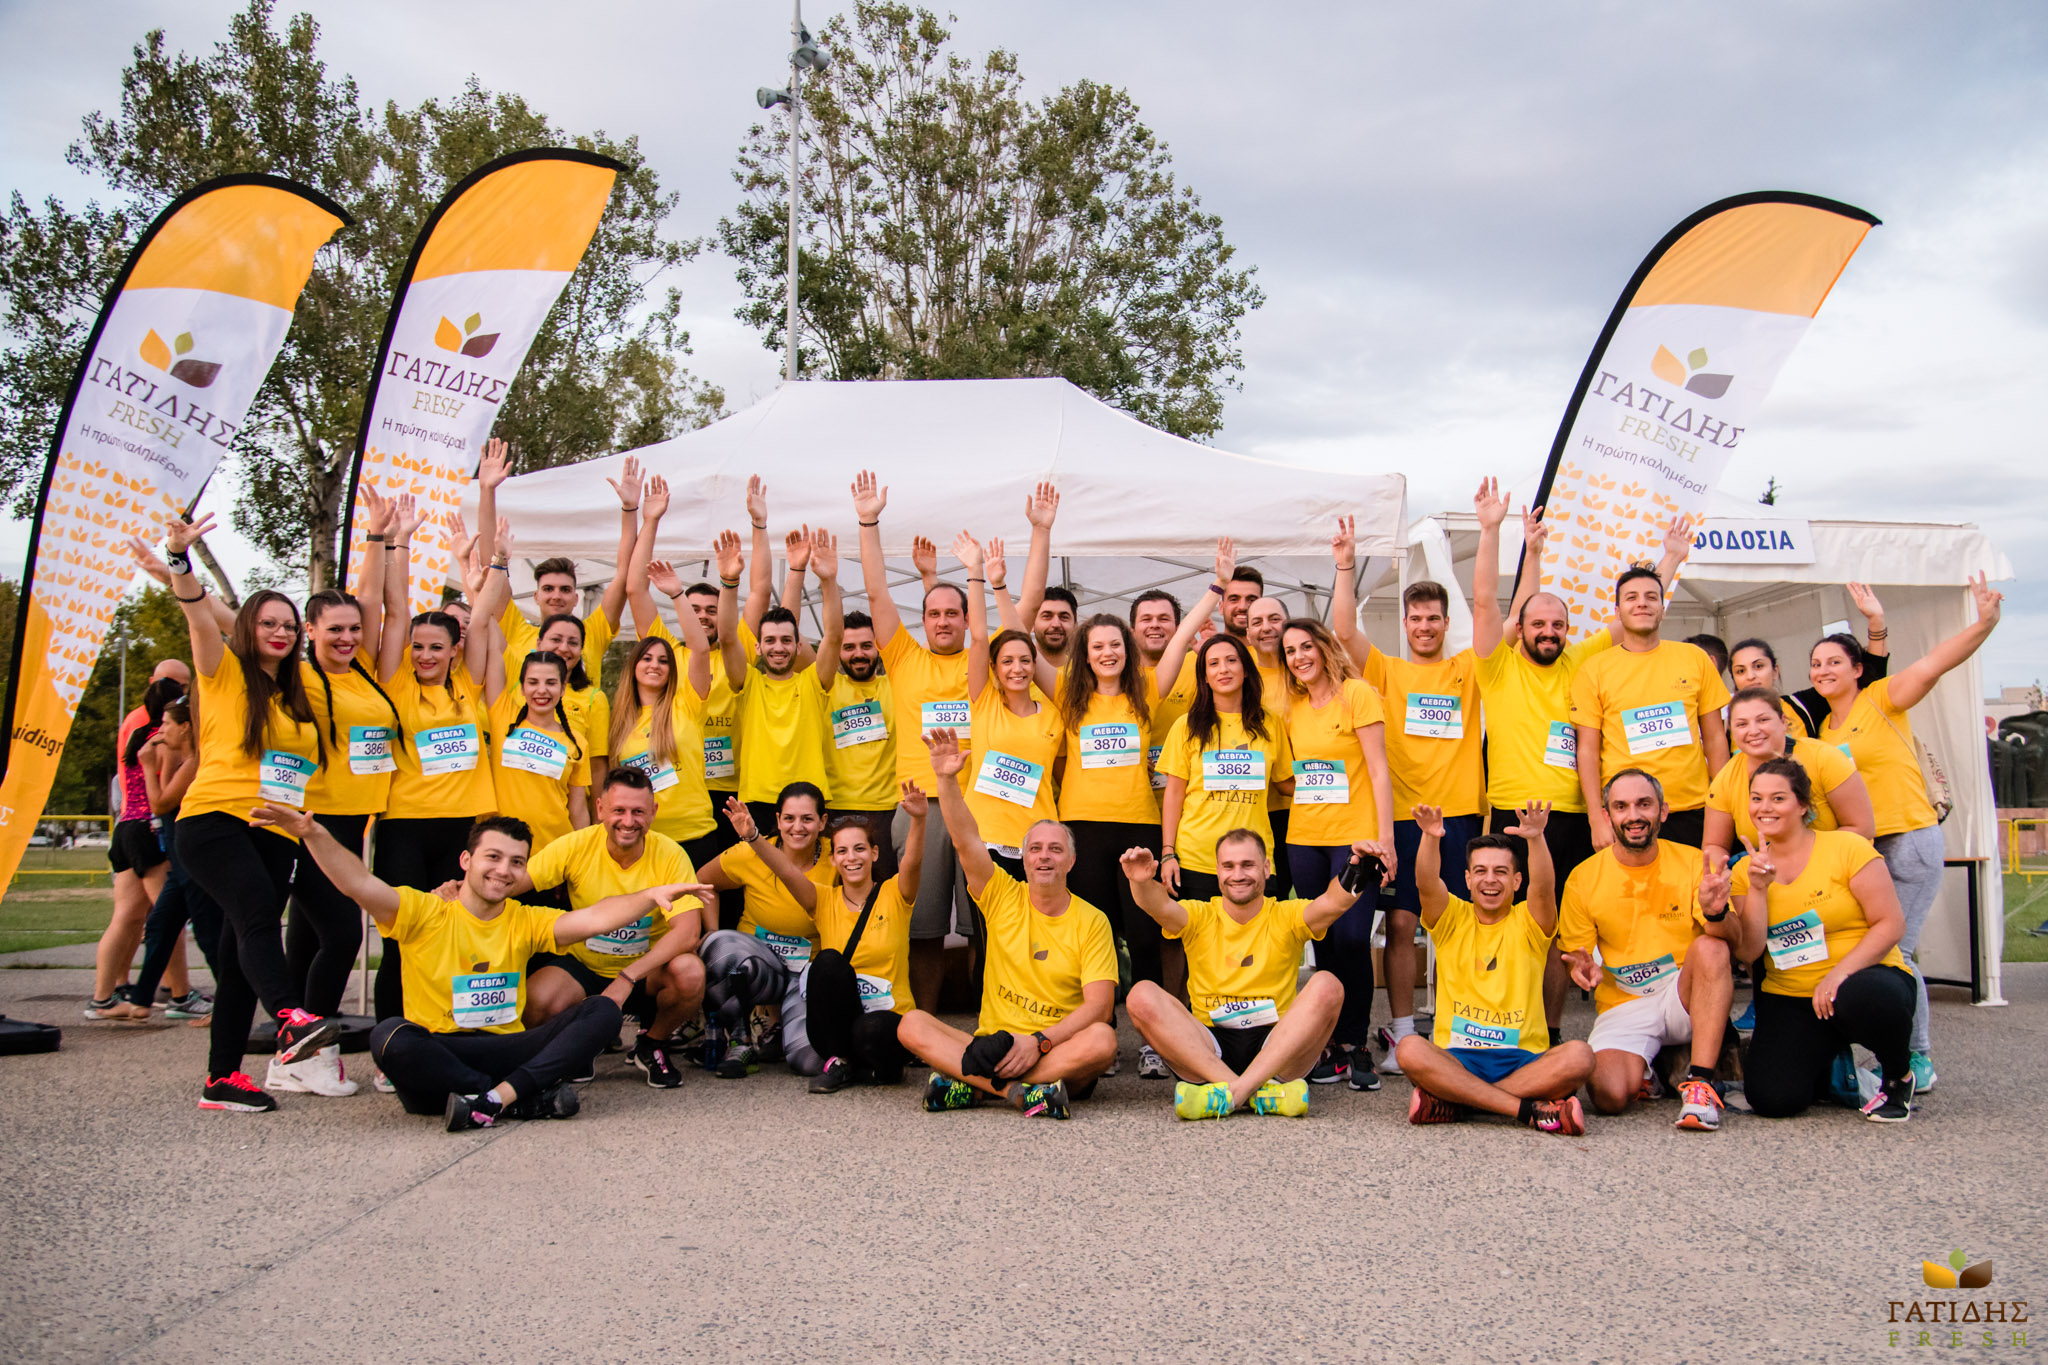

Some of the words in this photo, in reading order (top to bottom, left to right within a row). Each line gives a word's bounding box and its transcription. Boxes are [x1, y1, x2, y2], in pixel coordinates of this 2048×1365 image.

[387, 351, 508, 404] ΓΑΤΙΔΗΣ
[89, 357, 237, 448] ΓΑΤΙΔΗΣ
[412, 390, 465, 418] FRESH
[1592, 371, 1745, 448] ΓΑΤΙΔΗΣ
[80, 424, 91, 437] Η
[108, 400, 186, 449] FRESH
[1618, 415, 1701, 463] FRESH
[1582, 435, 1594, 449] Η
[1594, 443, 1638, 465] πρώτη
[1639, 454, 1708, 495] καλημέρα!
[1420, 697, 1453, 707] ΜΕΒΓΑΛ
[841, 706, 870, 718] ΜΕΒΓΑΛ
[935, 711, 967, 722] 3873
[1419, 709, 1452, 721] 3900
[1636, 706, 1671, 720] ΜΕΒΓΑΛ
[843, 716, 872, 731] 3859
[1639, 718, 1674, 734] 3876
[430, 728, 465, 741] ΜΕΒΓΑΛ
[522, 731, 556, 747] ΜΕΒΓΑΛ
[1094, 727, 1126, 736] ΜΕΒΓΑΛ
[433, 740, 467, 755] 3865
[518, 741, 553, 758] 3868
[704, 741, 722, 749] ΒΓΑΛ
[1093, 737, 1127, 751] 3870
[703, 751, 724, 762] 863
[997, 756, 1030, 773] ΜΕΒΓΑΛ
[1217, 763, 1251, 775] 3862
[1304, 762, 1333, 771] ΜΕΒΓΑΛ
[993, 767, 1026, 786] 3869
[1305, 774, 1334, 786] 3879
[1771, 919, 1806, 935] ΜΕΒΓΑΛ
[1780, 930, 1814, 948] 3891
[470, 977, 506, 988] ΜΕΒΓΑΛ
[1625, 966, 1660, 985] 3864
[471, 991, 506, 1006] 3860
[997, 984, 1064, 1018] ΓΑΤΙΔΗΣ
[1453, 1000, 1524, 1025] ΓΑΤΙΔΗΣ
[1466, 1025, 1503, 1041] ΜΕΒΓΑΛ
